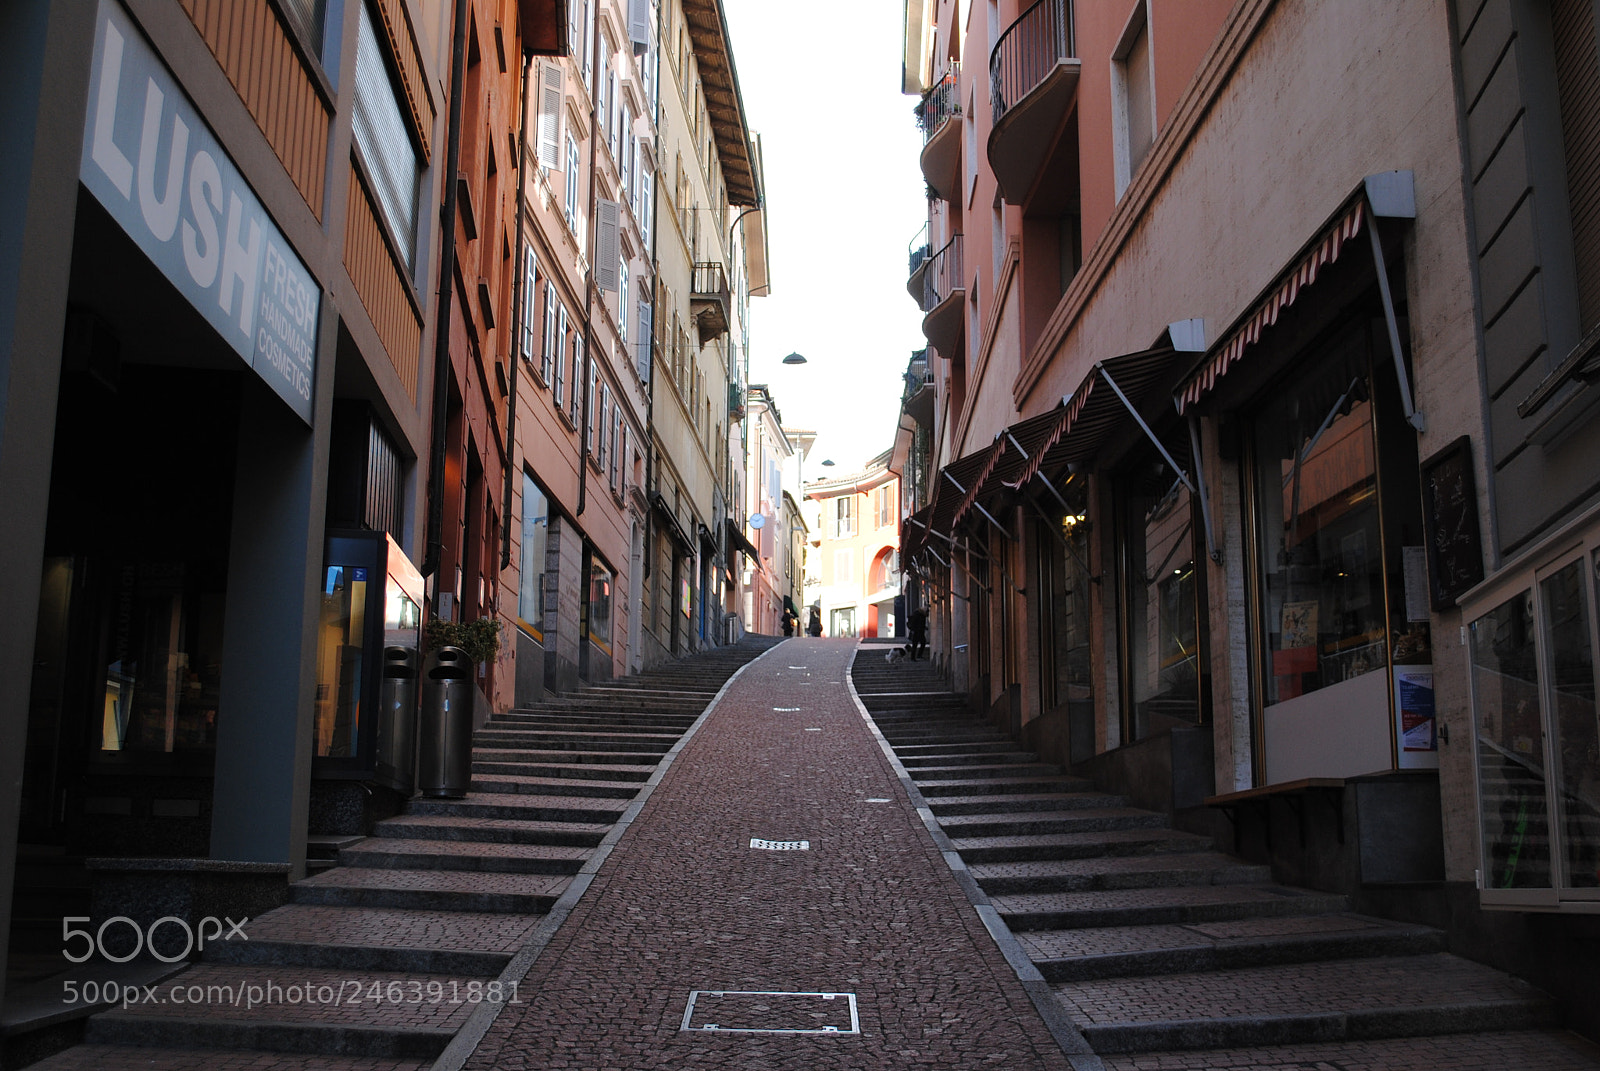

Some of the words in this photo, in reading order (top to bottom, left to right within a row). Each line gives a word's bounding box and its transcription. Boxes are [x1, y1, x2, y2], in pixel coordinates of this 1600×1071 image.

[91, 19, 262, 339] LUSH
[261, 295, 314, 371] HANDMADE
[264, 240, 316, 341] FRESH
[258, 326, 311, 402] COSMETICS
